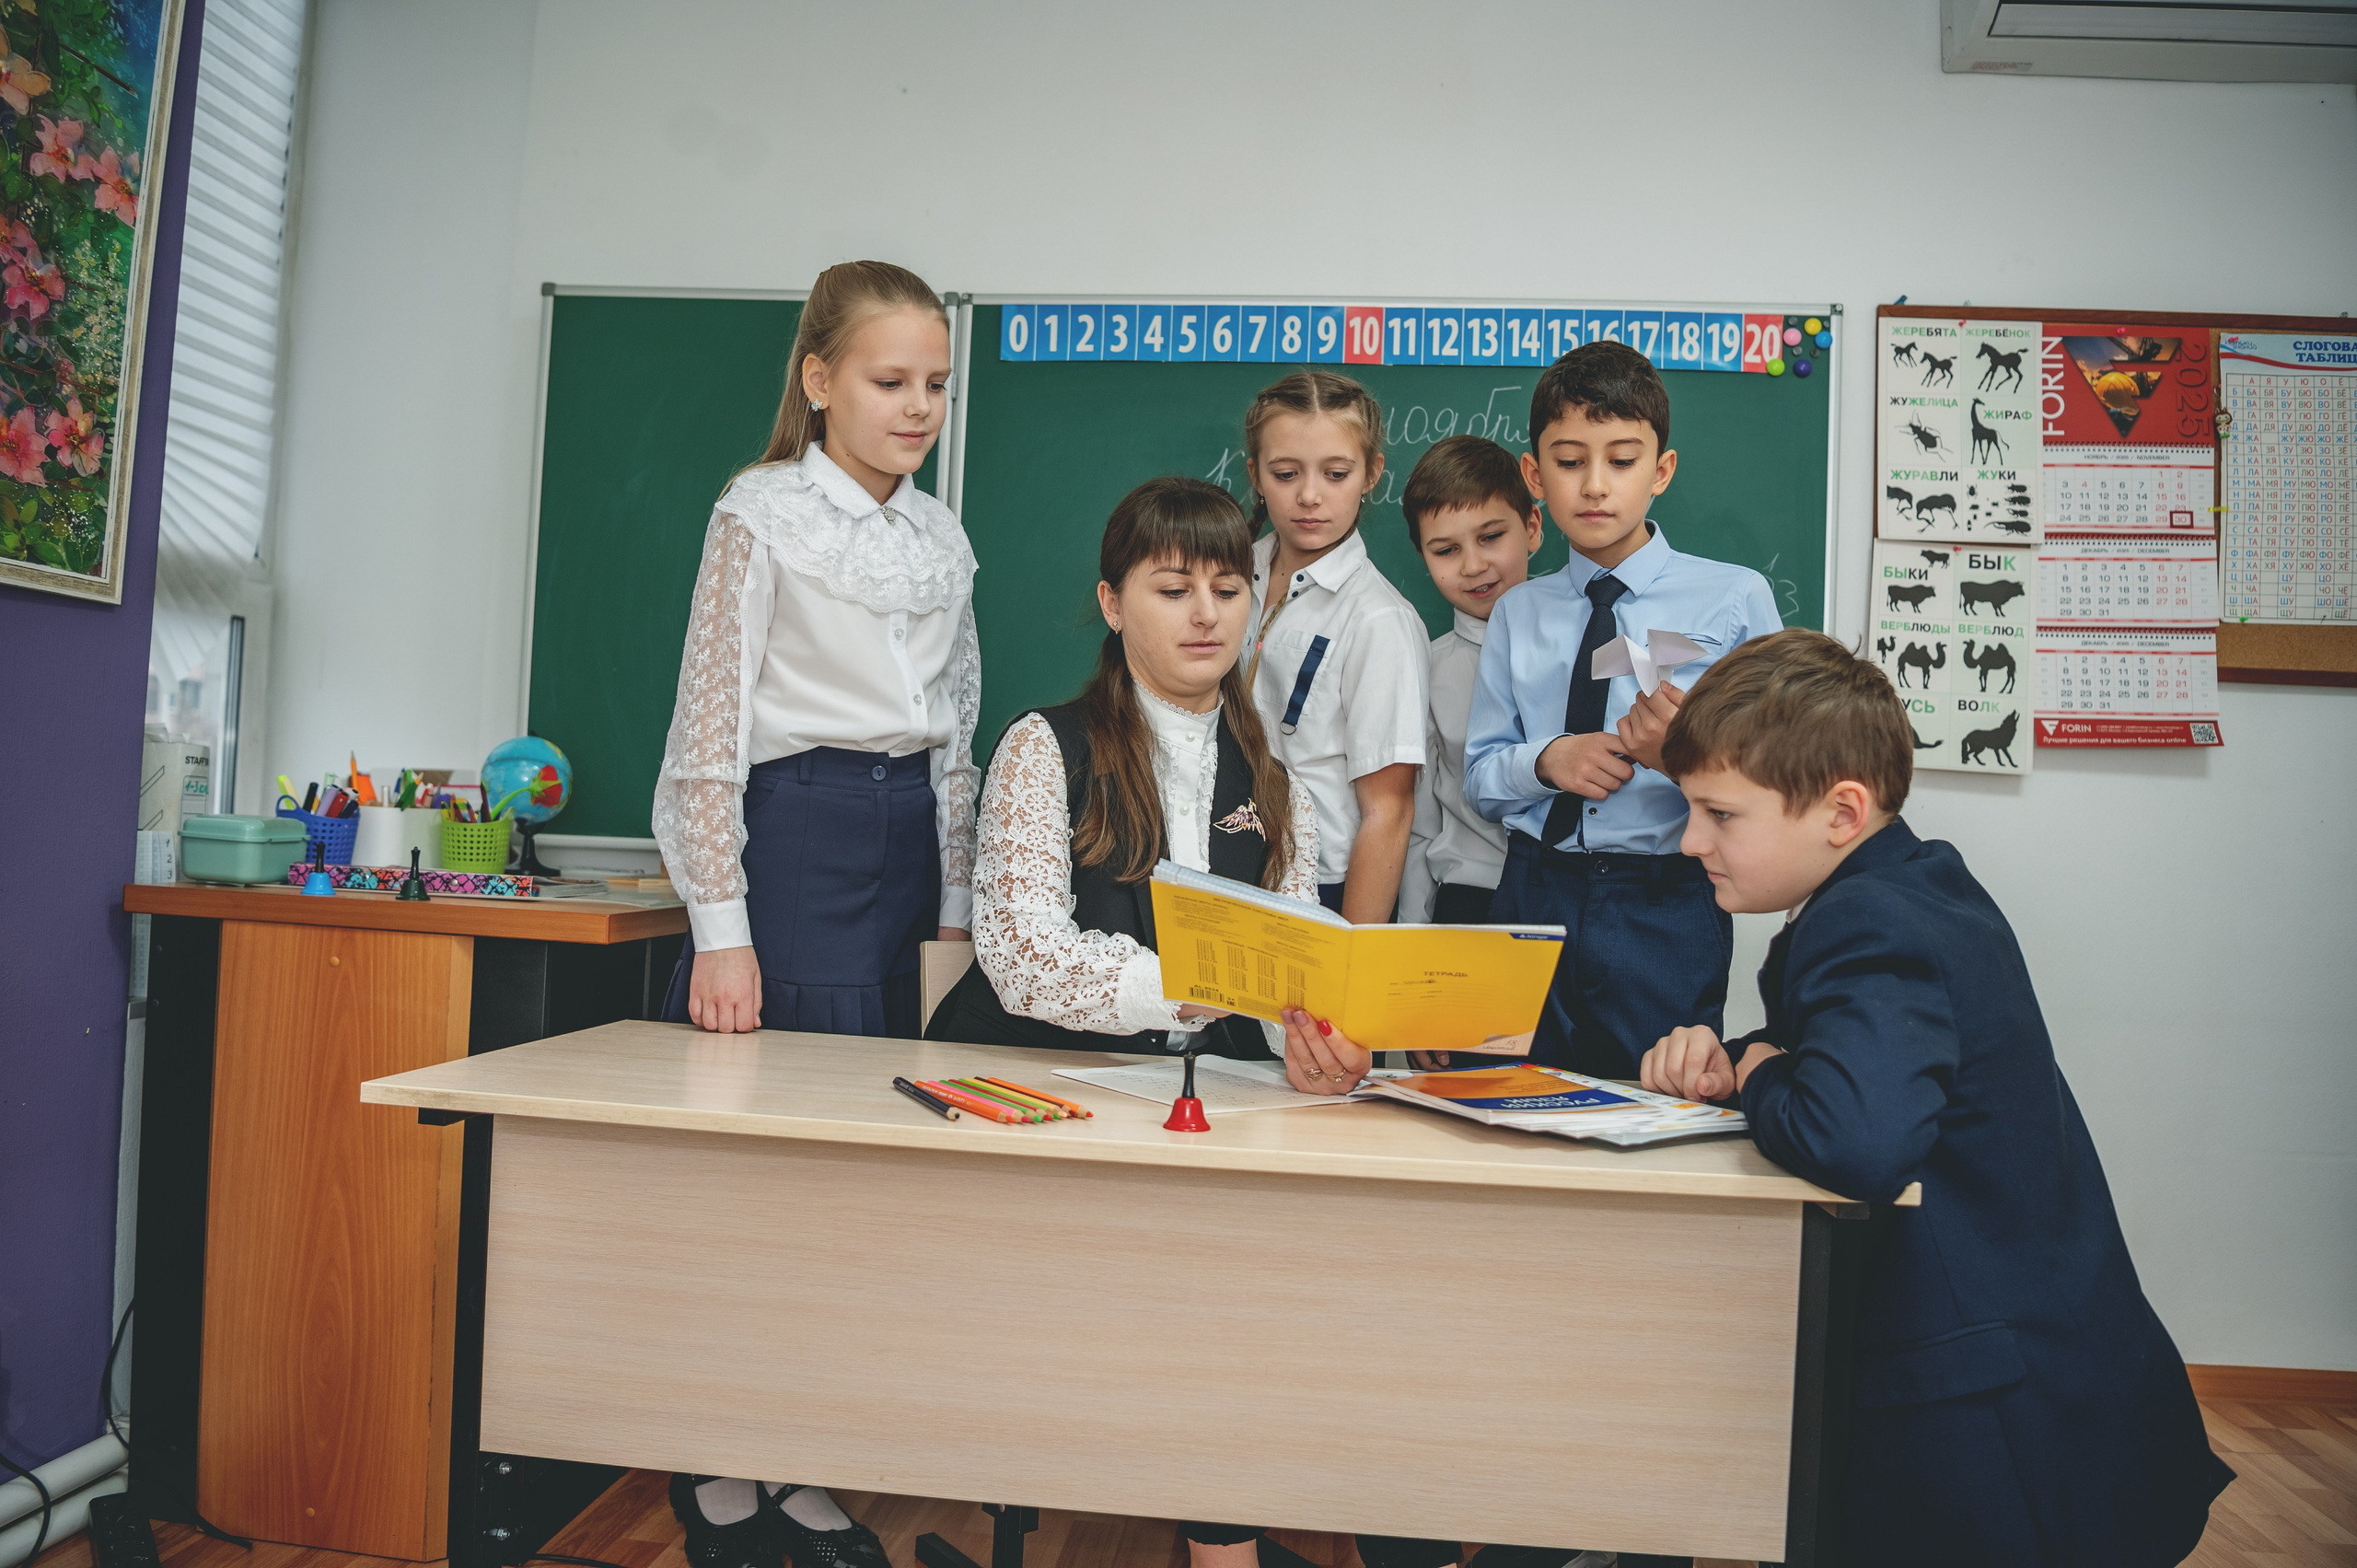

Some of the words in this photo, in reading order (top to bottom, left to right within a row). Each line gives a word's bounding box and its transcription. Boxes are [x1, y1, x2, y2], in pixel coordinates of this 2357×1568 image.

[1892, 327, 1957, 337] ЖЕРЕБЯТА
[1965, 327, 2031, 337] ЖЕРЕБЁНОК
[1009, 315, 1028, 353] 0
[1044, 315, 1058, 352] 1
[1075, 315, 1095, 353] 2
[1109, 315, 1128, 353] 3
[1144, 315, 1164, 353] 4
[1178, 315, 1197, 354] 5
[1213, 315, 1233, 354] 6
[1248, 316, 1267, 354] 7
[1282, 316, 1302, 354] 8
[1317, 316, 1337, 354] 9
[1349, 316, 1379, 355] 10
[1387, 318, 1416, 355] 11
[1427, 318, 1459, 356] 12
[1468, 318, 1498, 357] 13
[1507, 319, 1540, 357] 14
[1547, 319, 1580, 358] 15
[1627, 320, 1660, 360] 17
[1666, 321, 1701, 361] 18
[1706, 322, 1740, 362] 19
[1744, 323, 1781, 363] 20
[2296, 353, 2357, 364] ТАБЛИЦ
[2042, 336, 2065, 436] FORIN
[2175, 339, 2210, 439] 2025
[1890, 397, 1958, 407] ЖУЖЕЛИЦА
[2233, 399, 2237, 407] В
[1983, 410, 2032, 420] ЖИРАФ
[1891, 470, 1958, 481] ЖУРАВЛИ
[1978, 470, 2016, 480] ЖУКИ
[2285, 515, 2295, 523] РУ
[1968, 554, 2016, 571] БЫК
[2320, 563, 2331, 571] ХО
[1884, 566, 1929, 580] БЫКИ
[1880, 620, 1951, 634] ВЕРБЛЮДЫ
[1958, 624, 2025, 638] ВЕРБЛЮД
[1901, 699, 1935, 714] УСЬ
[1958, 700, 2000, 713] ВОЛК
[2061, 724, 2092, 733] FORIN
[167, 854, 171, 863] 2
[168, 870, 172, 879] 3
[1501, 1098, 1601, 1109] РУССКИЙ
